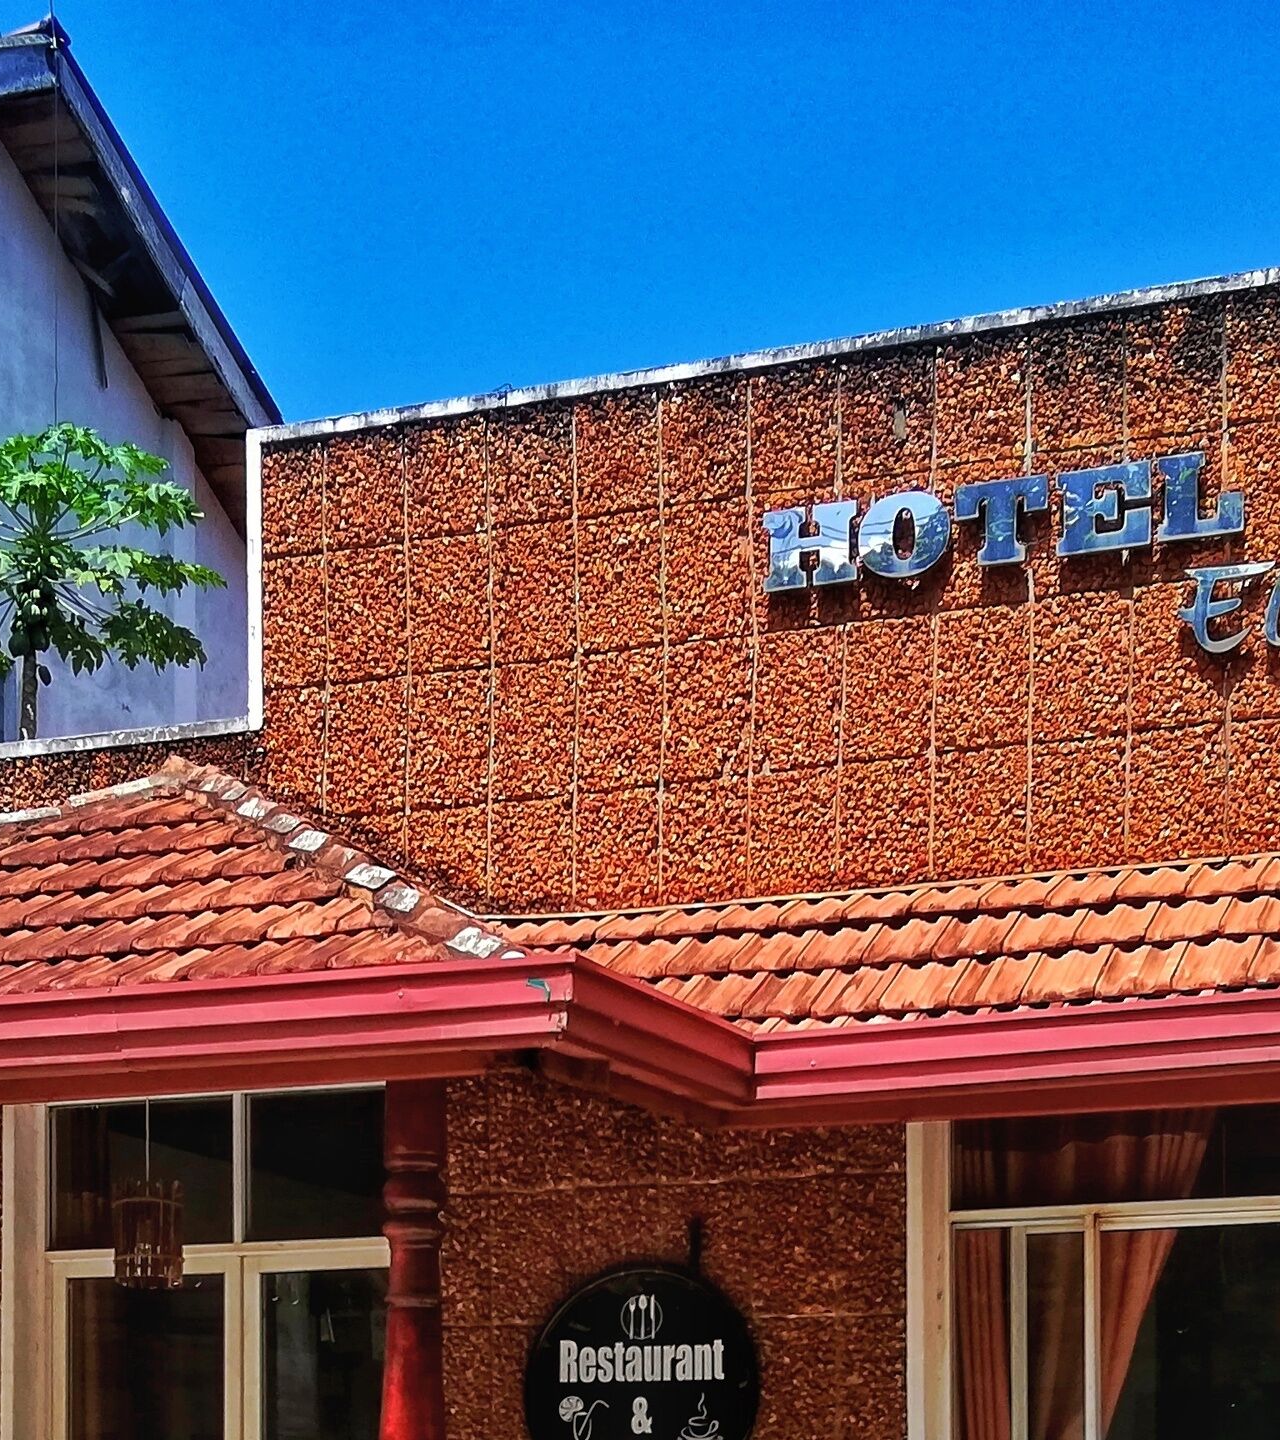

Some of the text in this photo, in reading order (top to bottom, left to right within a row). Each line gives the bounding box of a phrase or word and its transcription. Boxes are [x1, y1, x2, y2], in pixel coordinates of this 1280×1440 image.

[763, 452, 1245, 593] HOTEL
[558, 1339, 725, 1383] Restaurant
[631, 1396, 653, 1434] &
